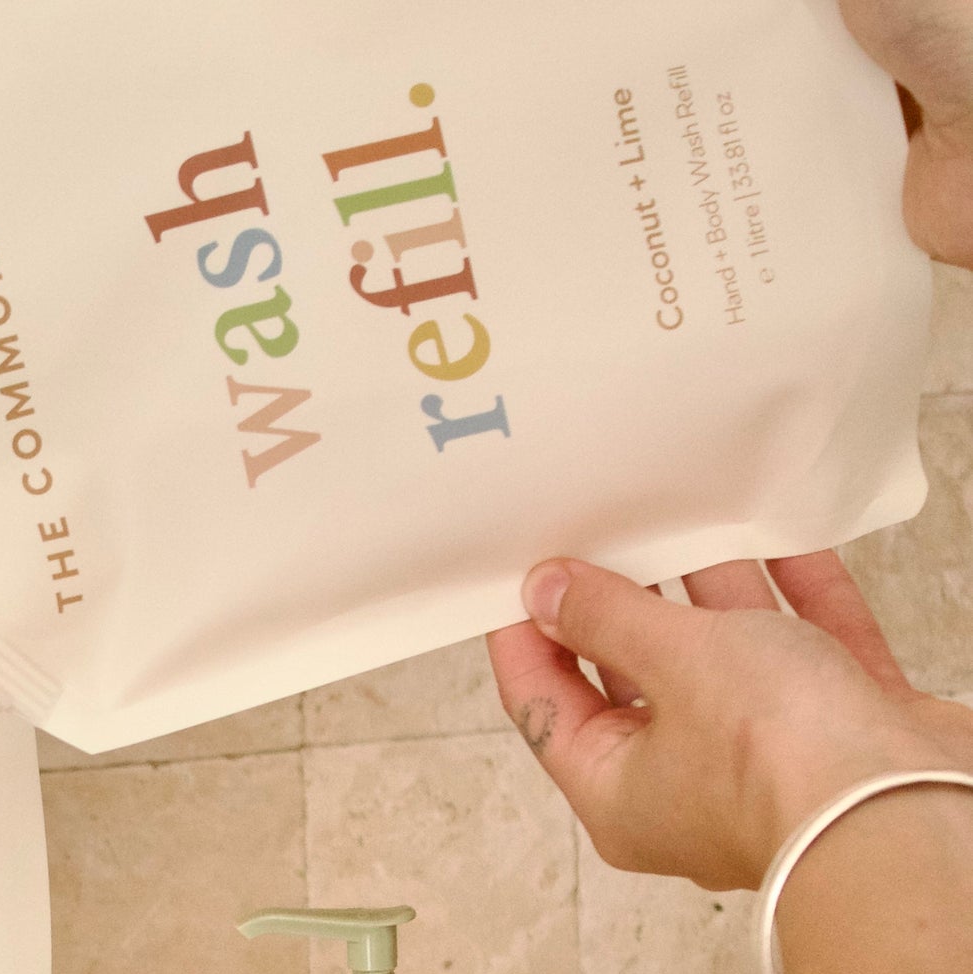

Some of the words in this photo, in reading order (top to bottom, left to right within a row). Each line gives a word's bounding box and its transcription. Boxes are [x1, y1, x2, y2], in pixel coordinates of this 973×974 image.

[666, 64, 696, 119] Refill
[717, 91, 734, 116] oz
[613, 87, 645, 167] Lime
[681, 122, 711, 186] Wash
[718, 120, 739, 135] fl
[698, 190, 727, 245] Body
[321, 82, 512, 454] refill.
[634, 198, 684, 331] Coconut
[715, 266, 746, 325] Hand
[143, 129, 322, 489] wash
[37, 515, 84, 614] THE
